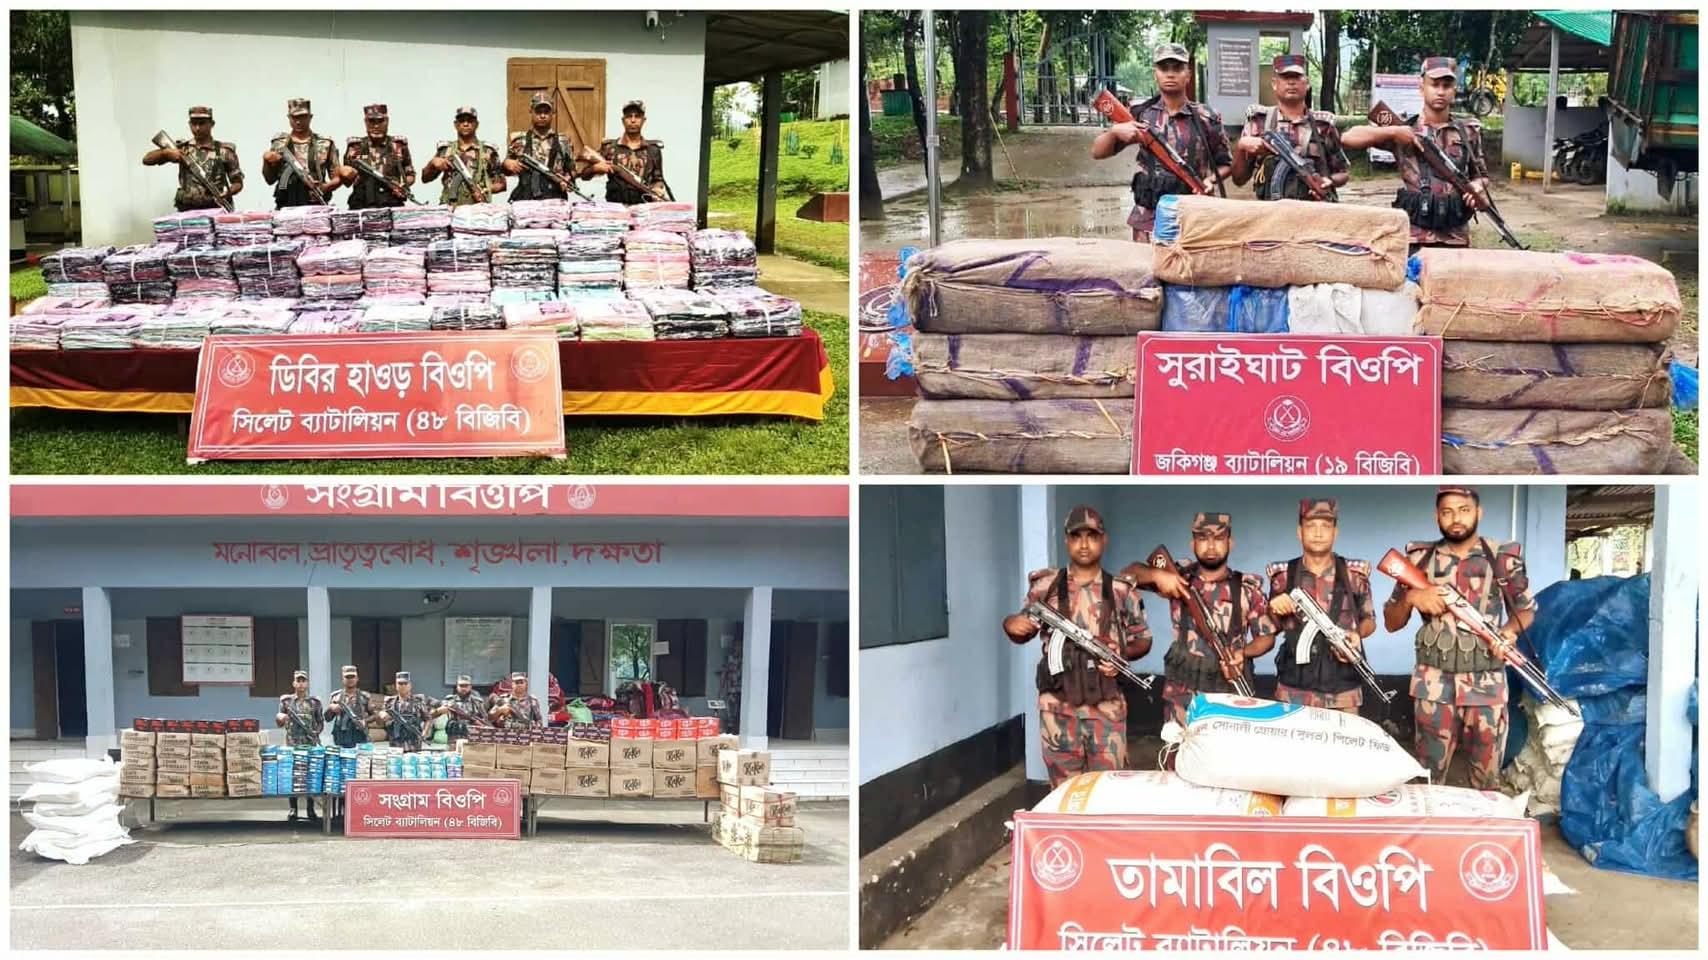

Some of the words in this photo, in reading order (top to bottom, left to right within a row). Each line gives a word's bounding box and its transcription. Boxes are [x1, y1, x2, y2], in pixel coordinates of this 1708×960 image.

[268, 353, 340, 396] ডিবির
[345, 360, 416, 399] হাওড়
[420, 350, 497, 393] বিওপি
[1154, 344, 1309, 390] সুরাইঘাট
[1318, 344, 1423, 385] বিওপি
[232, 408, 295, 434] সিলেট
[299, 405, 400, 433] ব্যাটালিয়ন
[406, 408, 448, 436] (৪৮
[455, 403, 531, 435] বিজিবি)
[1154, 447, 1218, 474] জকিগঞ্জ
[1225, 449, 1309, 474] ব্যাটালিয়ন
[1315, 453, 1348, 475] (১৯
[1355, 450, 1421, 475] বিজিবি)
[569, 538, 666, 565] দক্ষতা
[378, 791, 431, 810] সংগ্রাম
[435, 788, 487, 809] বিওপি
[363, 815, 392, 828] সিলেট
[395, 815, 440, 828] ব্যাটালিয়ন
[467, 815, 502, 829] বিজিবি)
[1105, 842, 1286, 911] তামাবিল
[1293, 844, 1434, 913] বিওপি
